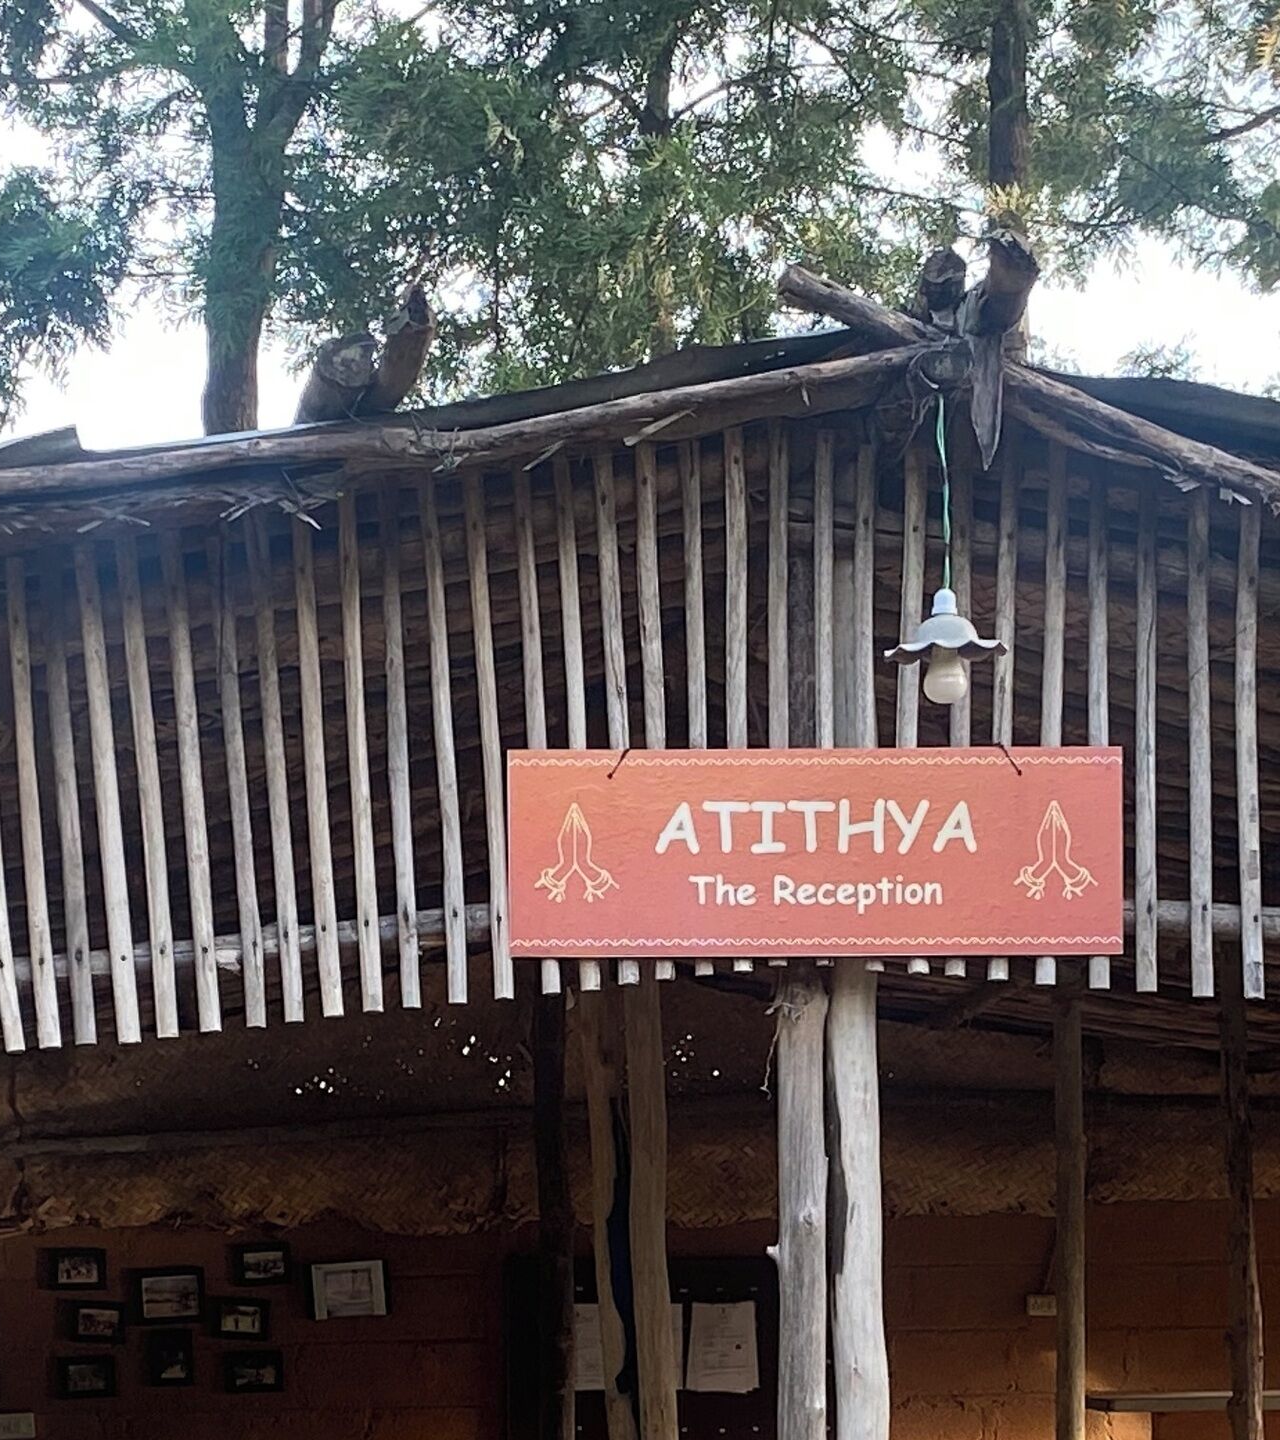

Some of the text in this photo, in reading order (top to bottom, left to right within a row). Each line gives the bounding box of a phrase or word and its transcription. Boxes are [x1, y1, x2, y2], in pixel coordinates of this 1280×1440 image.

[654, 797, 977, 855] ATITHYA
[688, 873, 943, 914] The Reception
